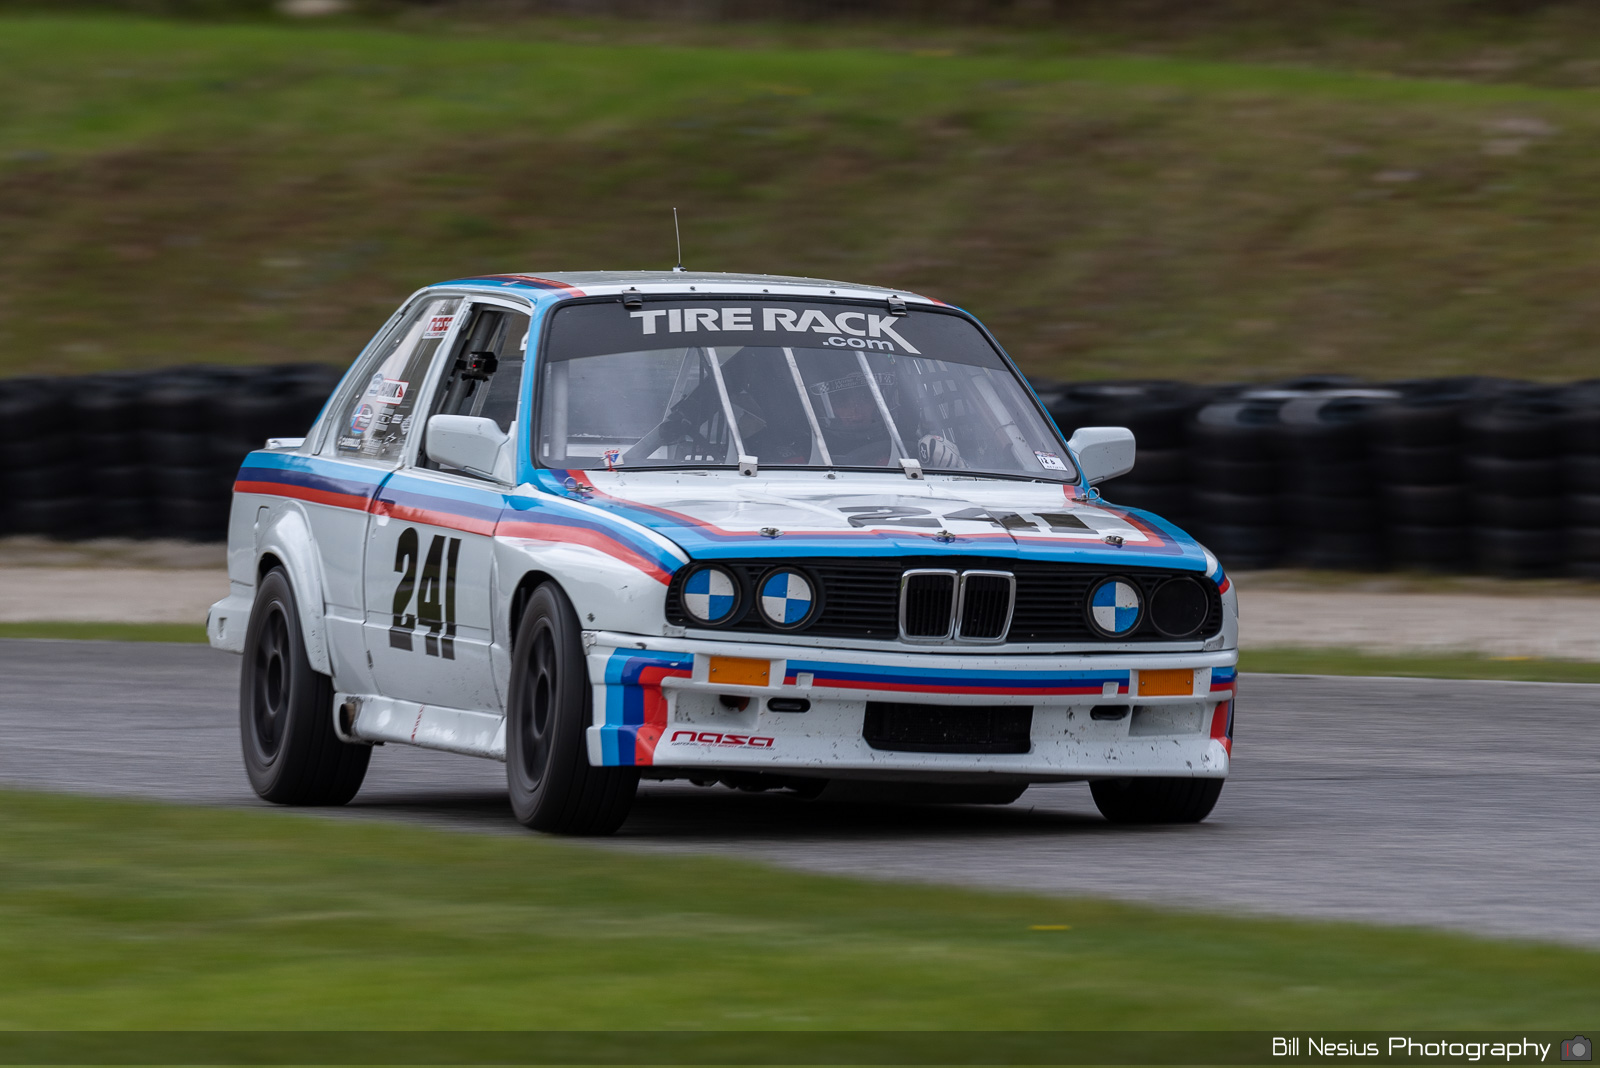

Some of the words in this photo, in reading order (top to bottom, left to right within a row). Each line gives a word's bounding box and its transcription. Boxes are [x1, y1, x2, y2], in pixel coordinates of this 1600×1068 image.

[629, 307, 754, 335] TIRE
[762, 307, 922, 355] RACK
[822, 336, 895, 351] .com
[838, 506, 1100, 535] 241
[389, 527, 463, 660] 241
[671, 730, 775, 747] nasa
